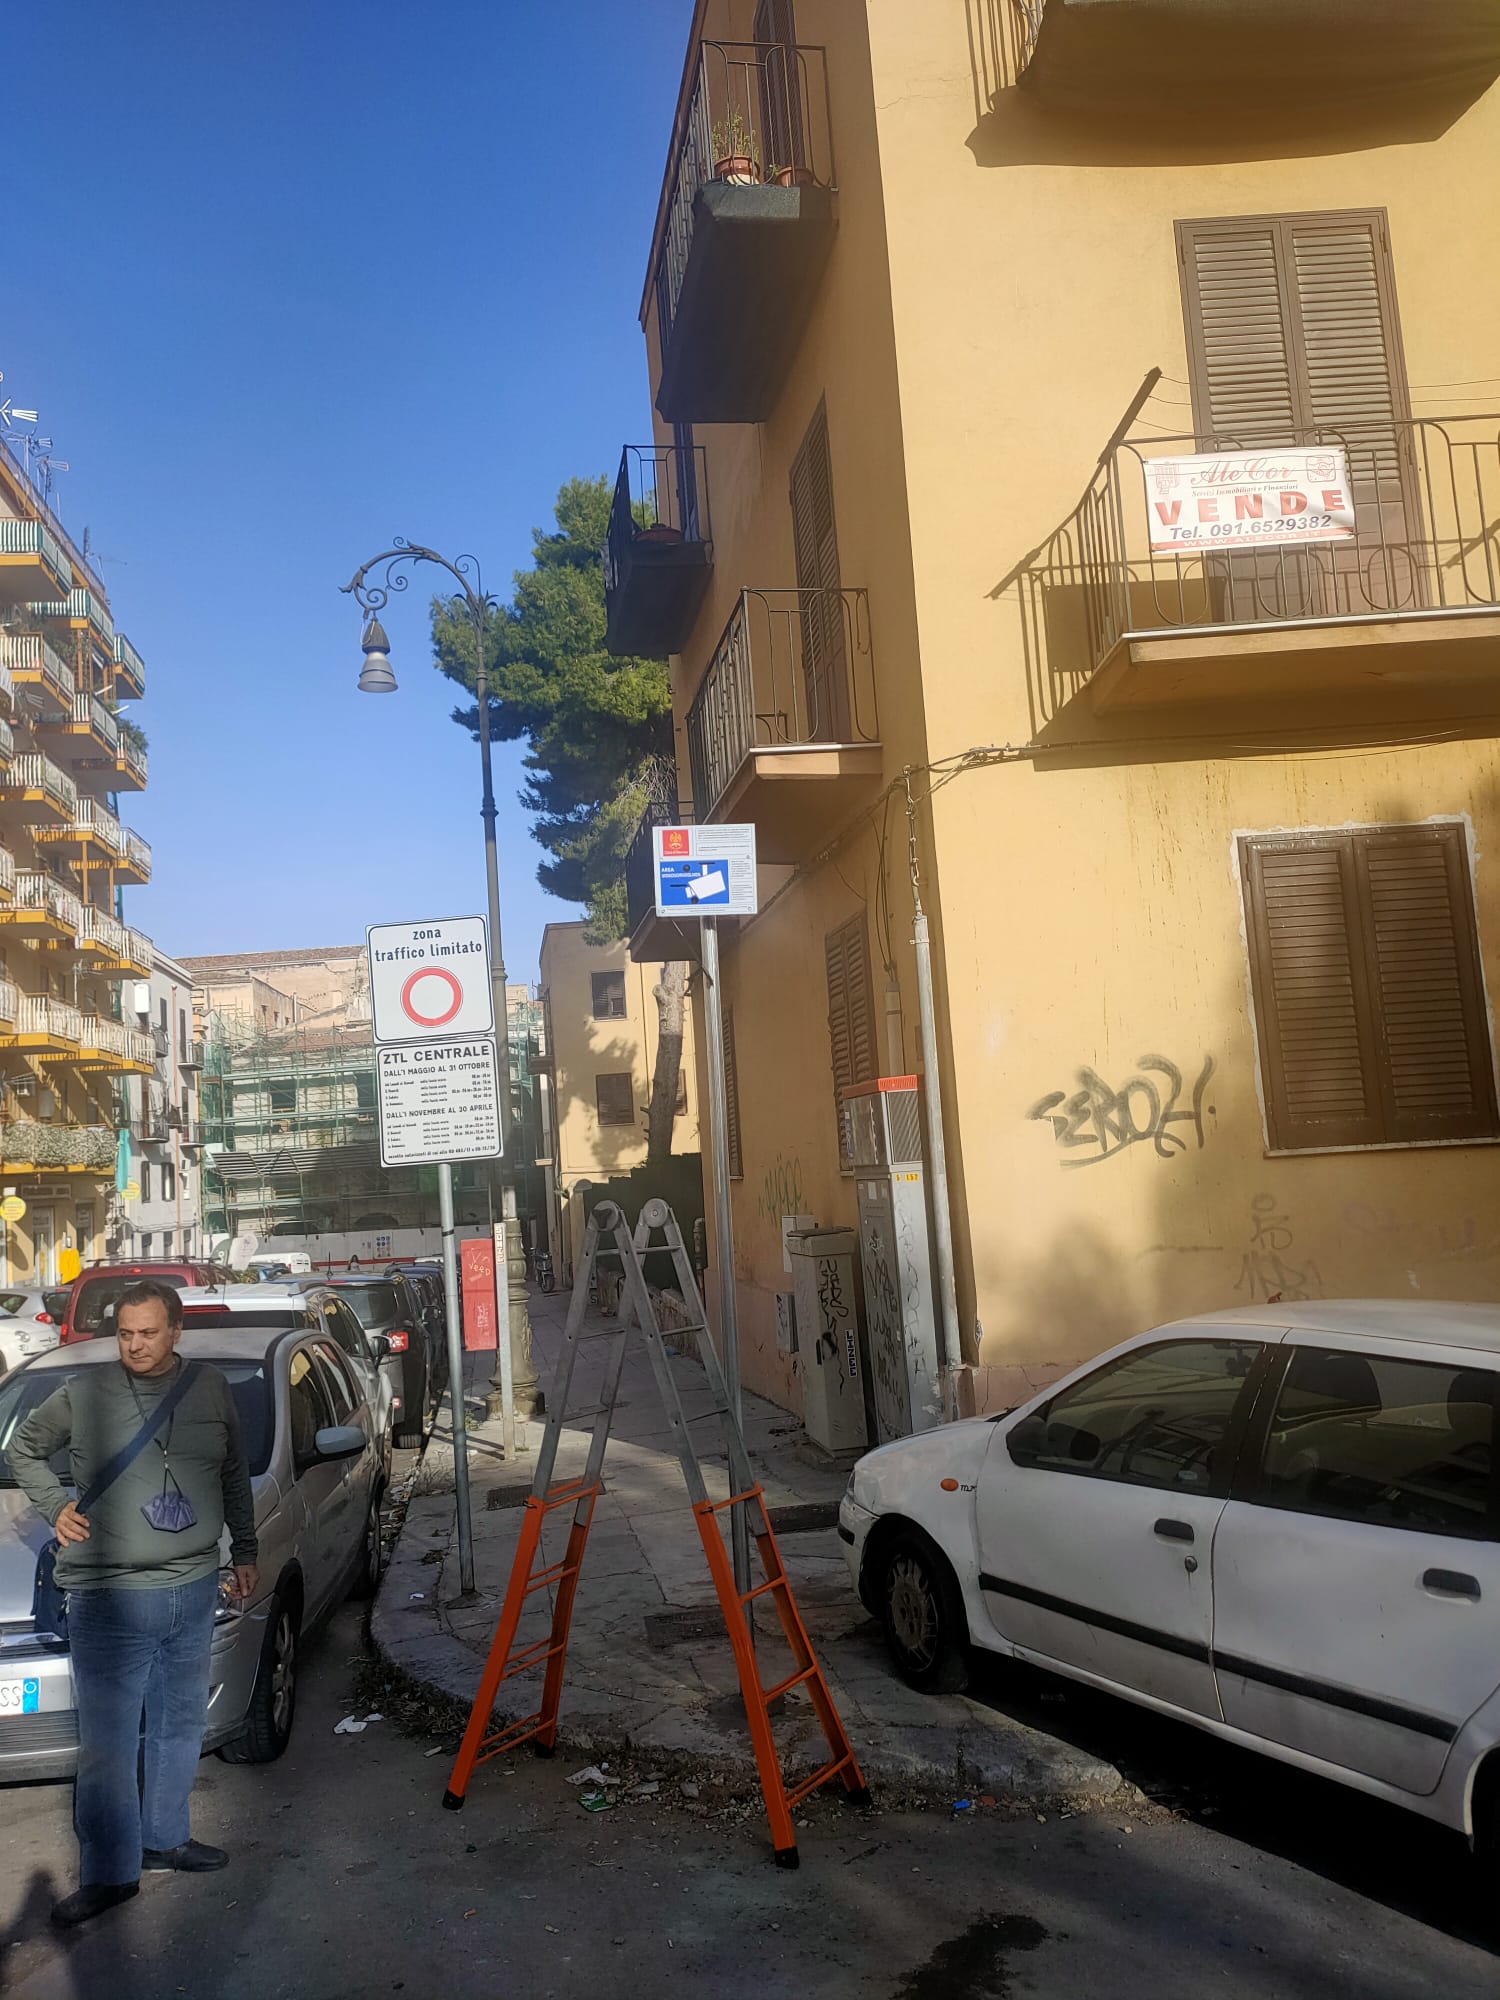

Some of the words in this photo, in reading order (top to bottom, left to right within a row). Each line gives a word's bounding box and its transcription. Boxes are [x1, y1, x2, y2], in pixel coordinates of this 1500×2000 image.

[1155, 489, 1345, 526] VENDE
[1170, 526, 1203, 540] Tel.
[1210, 514, 1332, 538] 091.6529382
[412, 928, 442, 941] zona
[375, 946, 425, 961] traffico
[430, 941, 482, 957] limitato
[383, 1052, 408, 1064] ZTL
[414, 1045, 490, 1062] CENTRALE
[408, 1066, 436, 1075] MAGGIO
[458, 1062, 490, 1071] OTTOBRE
[409, 1107, 446, 1117] NOVEMBRE
[448, 1106, 457, 1114] AL
[469, 1103, 493, 1112] APRILE
